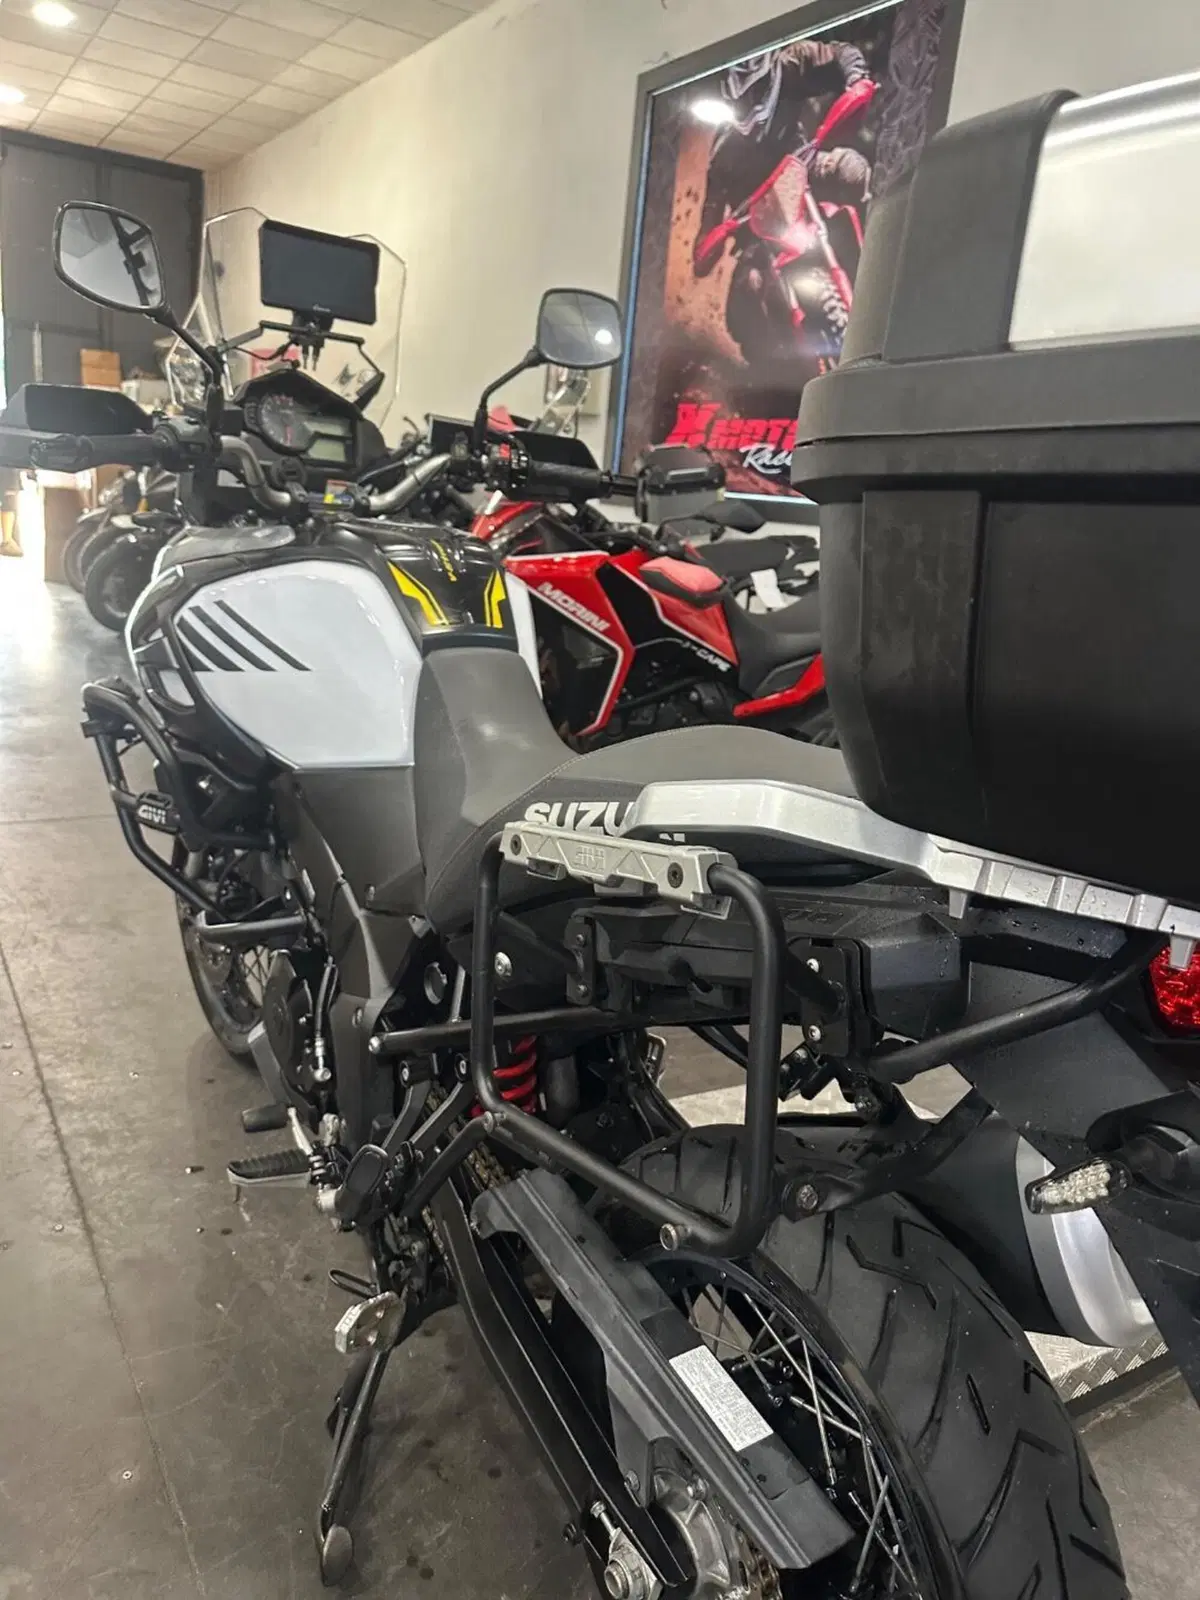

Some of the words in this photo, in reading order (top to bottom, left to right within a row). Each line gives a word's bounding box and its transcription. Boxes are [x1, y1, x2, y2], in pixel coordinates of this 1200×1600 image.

[537, 582, 611, 632] MORINI
[137, 804, 167, 826] GIVI
[524, 801, 686, 843] SUZU
